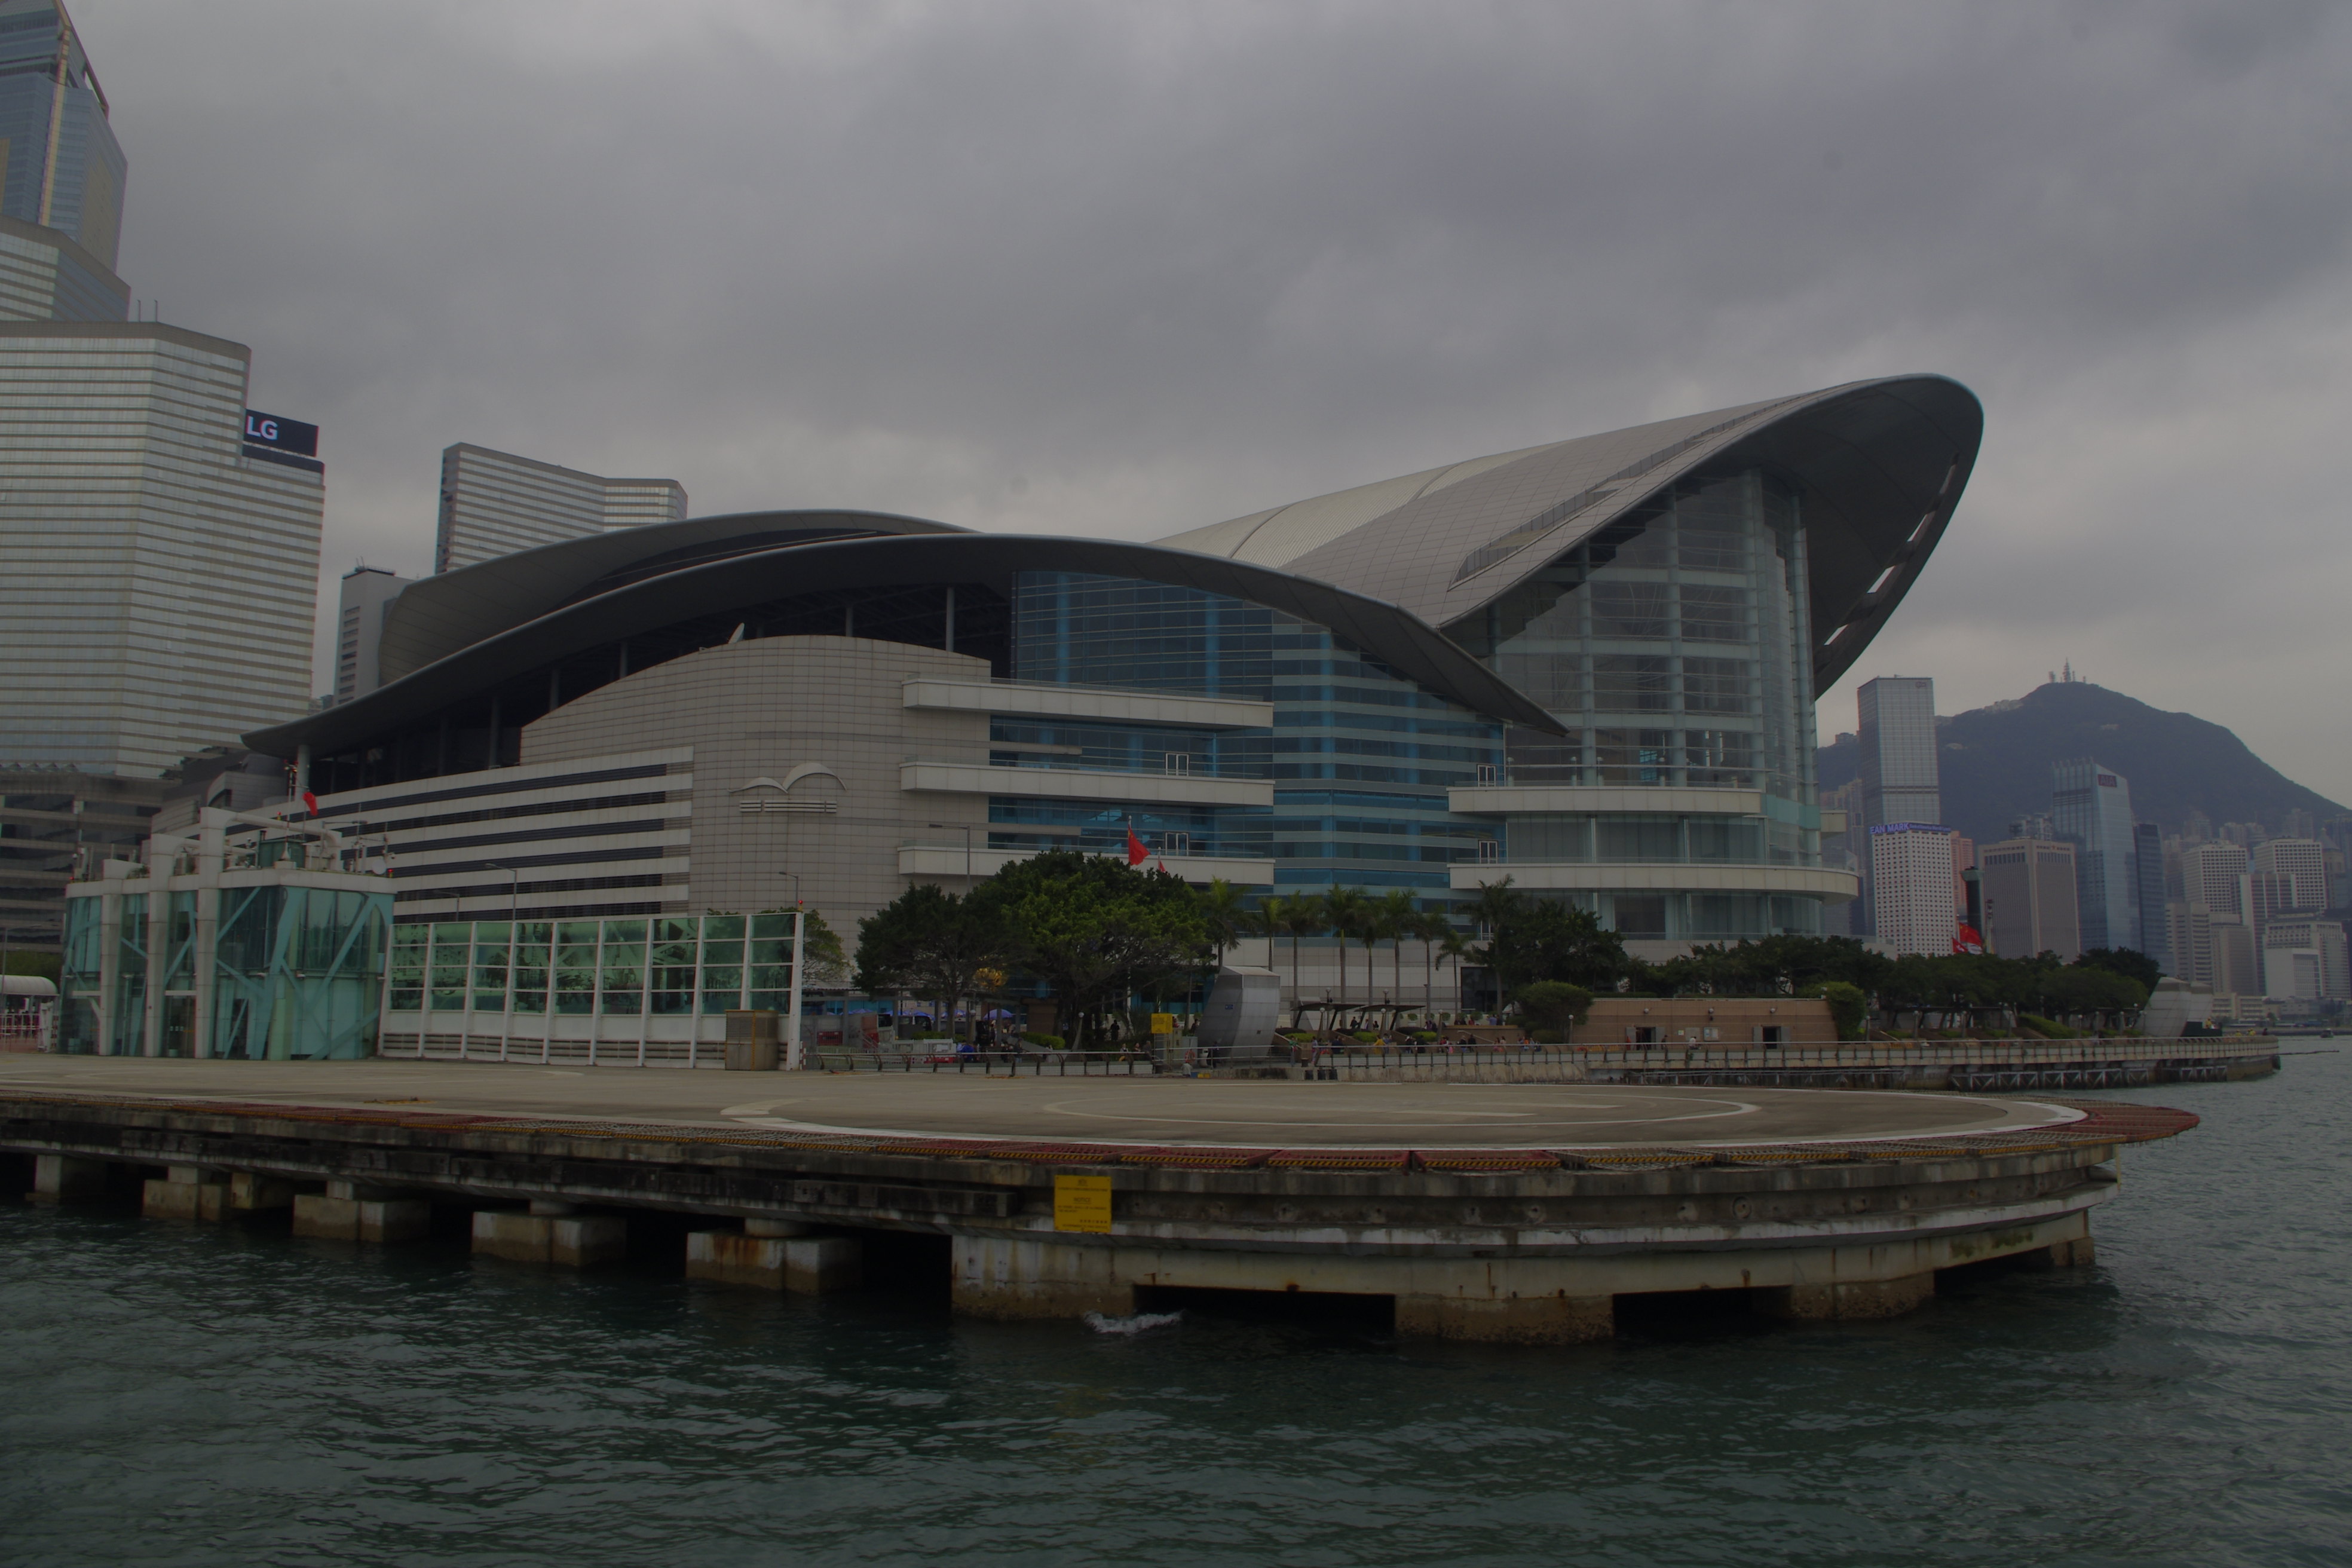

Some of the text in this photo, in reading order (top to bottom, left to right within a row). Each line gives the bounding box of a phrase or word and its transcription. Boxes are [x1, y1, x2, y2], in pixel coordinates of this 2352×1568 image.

[246, 415, 278, 440] LG
[1870, 825, 1885, 834] EAN
[1888, 822, 1909, 832] MARK
